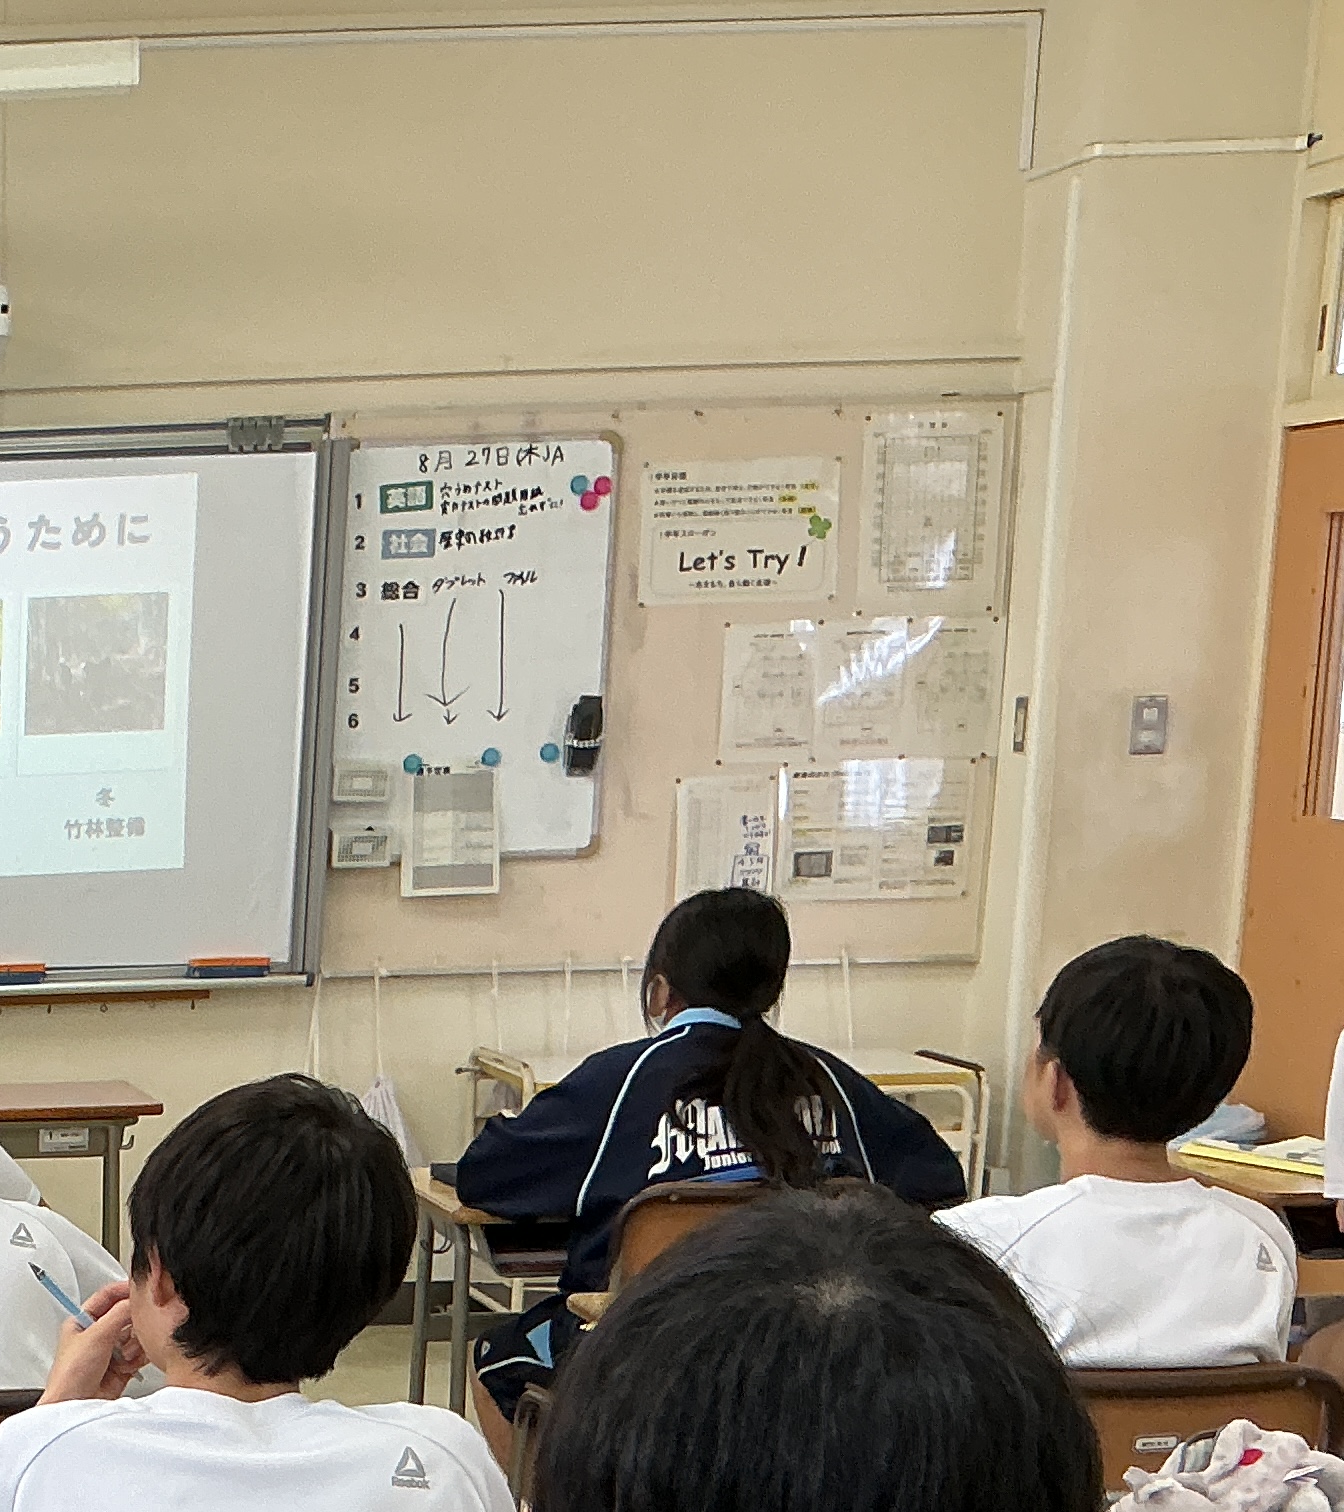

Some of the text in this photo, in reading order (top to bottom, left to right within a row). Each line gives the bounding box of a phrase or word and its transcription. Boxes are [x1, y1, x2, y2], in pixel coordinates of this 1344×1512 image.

[355, 493, 362, 510] 1
[355, 535, 365, 550] 2
[389, 533, 428, 554] 社会
[678, 550, 736, 572] Let's
[356, 582, 366, 598] 3
[349, 626, 360, 640] 4
[348, 677, 360, 693] 5
[348, 713, 359, 728] 6
[96, 788, 115, 807] 冬
